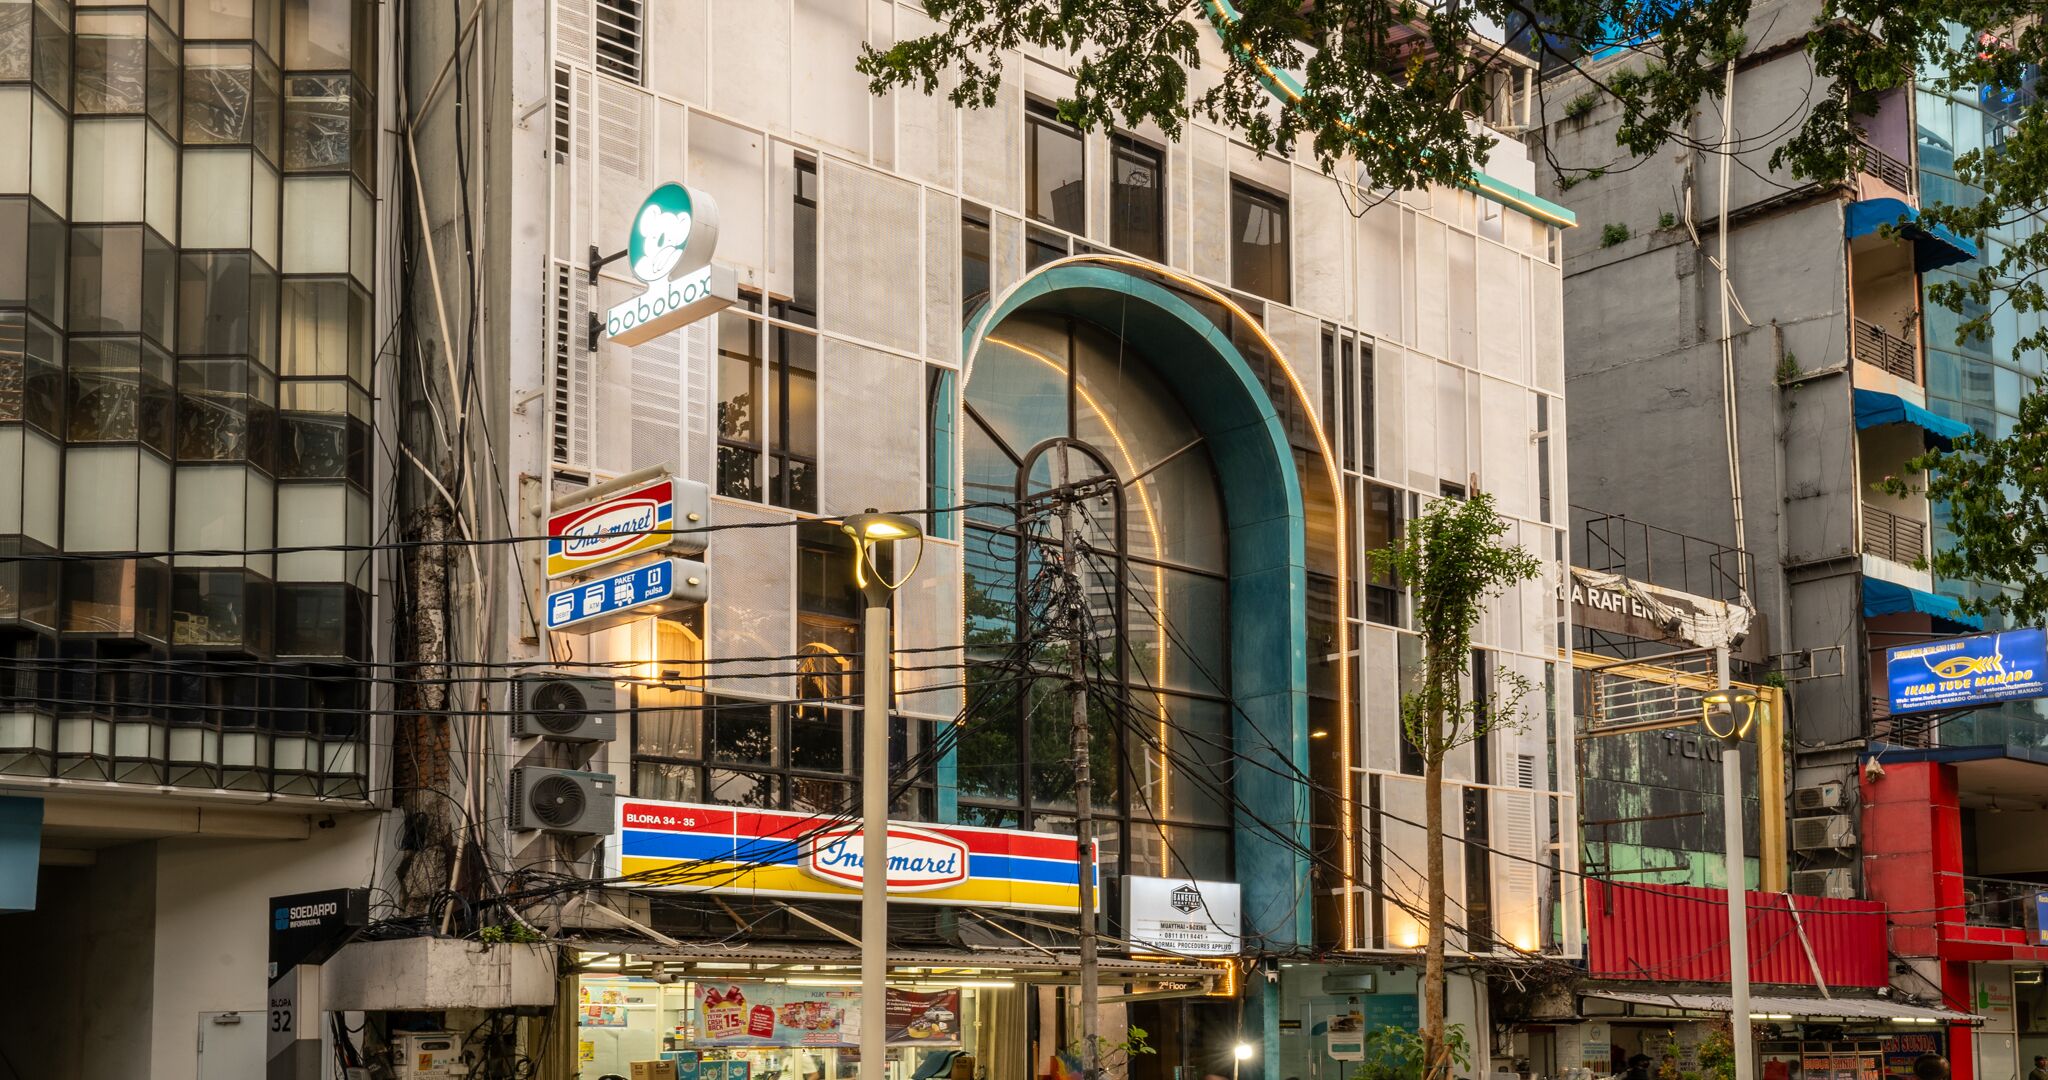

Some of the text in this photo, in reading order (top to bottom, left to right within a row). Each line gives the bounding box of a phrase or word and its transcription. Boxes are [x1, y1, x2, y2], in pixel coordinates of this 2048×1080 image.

[608, 276, 711, 336] bobobox
[614, 573, 636, 586] PAKET
[644, 585, 663, 599] pulsa
[589, 601, 600, 610] ATM
[1588, 588, 1628, 614] RAFI
[555, 611, 569, 620] DEBIT
[1904, 669, 2033, 696] IKAN TUDE MANADO
[626, 813, 661, 825] BLORA
[663, 815, 676, 826] 34
[683, 817, 695, 827] 35
[821, 841, 956, 874] Inmaret
[290, 902, 337, 919] SOEDARPO
[290, 918, 321, 929] INFORMATIKA
[1160, 922, 1207, 931] MUAYTHAI BOXING
[1169, 981, 1187, 990] Floor
[271, 998, 292, 1008] BLORA
[271, 1010, 292, 1032] 32
[1901, 1035, 1937, 1053] SUNDA
